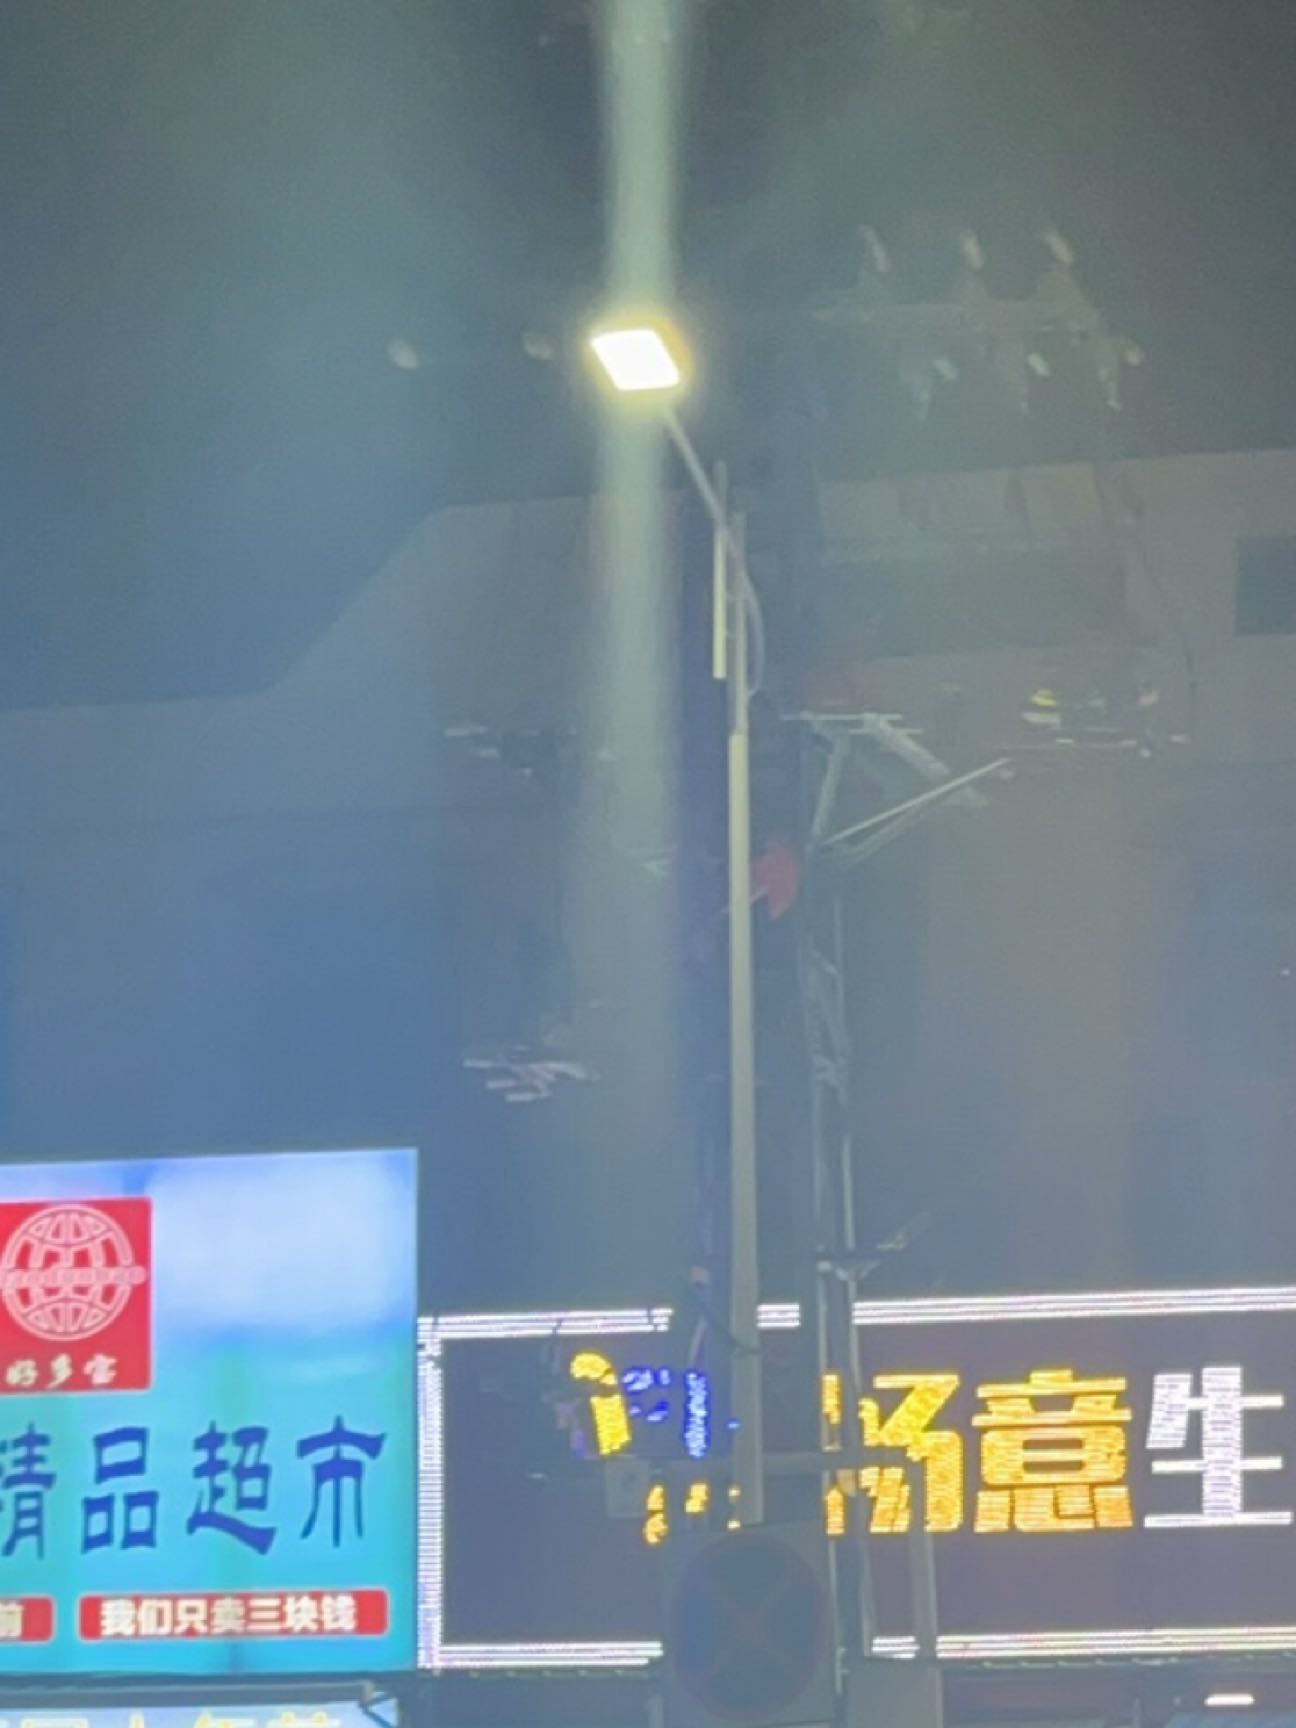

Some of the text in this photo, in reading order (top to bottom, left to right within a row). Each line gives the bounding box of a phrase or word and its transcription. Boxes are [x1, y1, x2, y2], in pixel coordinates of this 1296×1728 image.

[0, 1415, 387, 1561] 精品超市
[101, 1594, 357, 1636] 我们只卖三块钱
